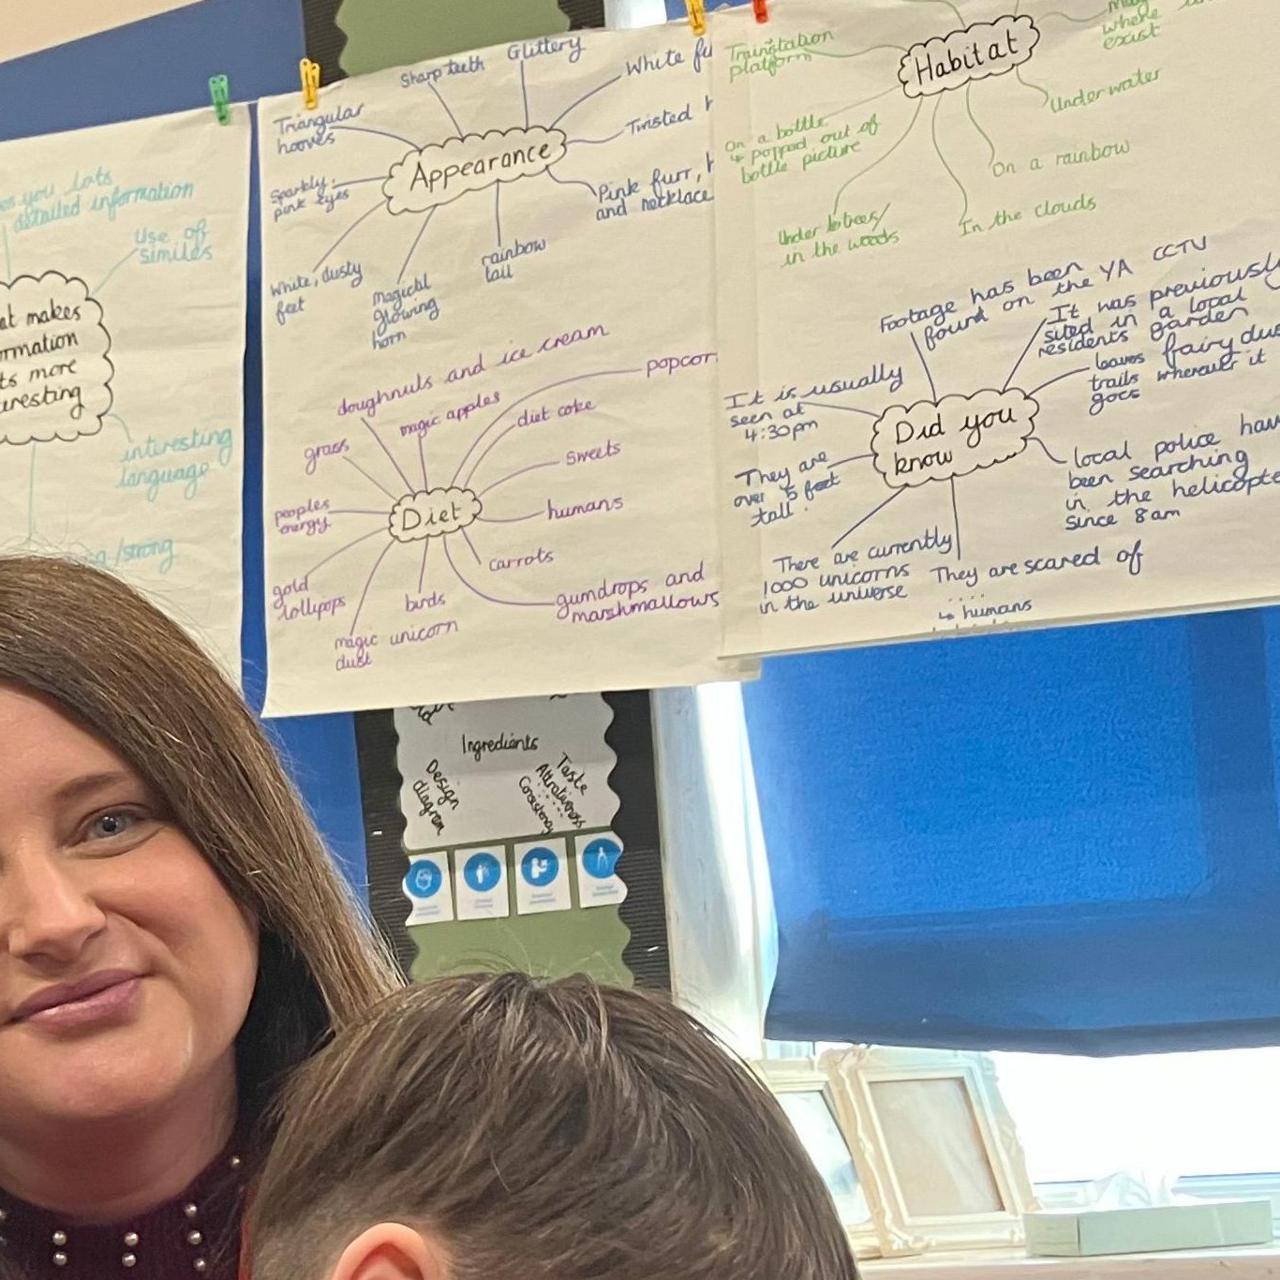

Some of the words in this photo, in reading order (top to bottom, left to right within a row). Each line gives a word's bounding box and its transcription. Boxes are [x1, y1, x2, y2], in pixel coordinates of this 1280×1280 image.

[507, 36, 586, 64] Glittery
[1103, 23, 1160, 50] exist
[400, 68, 442, 89] Sharp
[443, 55, 486, 76] teeth
[625, 50, 685, 77] White
[729, 52, 812, 84] platform
[915, 28, 1019, 85] Habitat
[272, 103, 365, 144] Triangular
[624, 104, 693, 137] Twisted
[757, 133, 767, 145] a
[776, 113, 828, 140] bottle
[820, 124, 850, 144] out
[857, 112, 880, 137] of
[409, 141, 552, 194] Appearance
[740, 161, 788, 184] bottle
[802, 141, 861, 171] picture
[992, 160, 1017, 178] On
[1030, 157, 1044, 171] a
[1056, 140, 1130, 166] rainbow
[91, 181, 194, 222] information
[596, 198, 628, 221] and
[641, 188, 714, 213] necklace
[598, 178, 640, 204] Pink
[134, 228, 168, 245] Use
[184, 218, 209, 249] of
[778, 226, 820, 246] Under
[959, 219, 982, 237] In
[988, 209, 1023, 230] the
[139, 241, 213, 265] similes
[481, 238, 548, 267] rainbow
[780, 252, 806, 269] in
[813, 241, 839, 258] the
[848, 228, 900, 252] woods
[1099, 259, 1134, 282] YA
[1152, 235, 1208, 261] CCTV
[321, 260, 363, 289] dusty
[485, 264, 513, 284] tail
[26, 298, 82, 327] makes
[276, 297, 305, 326] feet
[880, 300, 957, 334] Footage
[970, 280, 1015, 304] has
[1028, 262, 1083, 287] been
[924, 306, 989, 351] found
[1002, 295, 1035, 312] on
[1052, 276, 1094, 298] the
[1047, 303, 1080, 325] It
[1110, 313, 1138, 330] in
[1159, 306, 1174, 320] a
[1190, 286, 1248, 315] local
[373, 297, 440, 337] glowing
[1038, 330, 1129, 358] residents
[1150, 307, 1249, 342] garden
[372, 330, 407, 350] horn
[1095, 352, 1145, 370] leaves
[1162, 332, 1236, 368] fairy
[28, 359, 78, 383] more
[338, 373, 433, 417] doughnuts
[444, 352, 486, 384] and
[496, 340, 533, 368] ice
[537, 324, 609, 354] cream
[1089, 370, 1140, 392] trails
[1156, 357, 1238, 382] wherever
[1249, 348, 1266, 366] it
[724, 390, 764, 411] It
[774, 385, 798, 402] is
[800, 363, 903, 399] usually
[1089, 389, 1141, 416] goes
[446, 391, 501, 422] apples
[517, 407, 549, 428] diet
[558, 399, 597, 418] coke
[730, 411, 773, 428] seen
[783, 402, 806, 419] at
[745, 420, 818, 442] 4:30pm
[896, 413, 945, 445] Did
[959, 408, 1017, 449] you
[120, 427, 234, 467] interesting
[303, 438, 350, 475] grass
[895, 451, 953, 475] know
[1154, 432, 1221, 462] police
[115, 461, 210, 502] language
[735, 466, 792, 492] They
[799, 451, 828, 473] are
[1069, 471, 1114, 489] been
[1129, 449, 1249, 484] searching
[734, 492, 766, 508] over
[805, 471, 841, 501] feet
[1066, 493, 1088, 511] in
[1107, 488, 1152, 507] the
[274, 499, 330, 528] peoples
[402, 501, 462, 532] Diet
[547, 496, 624, 521] humans
[1065, 514, 1118, 530] since
[279, 516, 331, 536] energy
[489, 546, 554, 572] carrots
[773, 555, 820, 573] There
[834, 550, 859, 565] are
[868, 526, 953, 559] currently
[930, 566, 978, 588] They
[989, 562, 1020, 578] are
[1024, 546, 1101, 575] scared
[1116, 539, 1144, 576] of
[272, 575, 309, 610] gold
[556, 577, 649, 620] gumdrops
[665, 560, 705, 587] and
[763, 577, 808, 597] 1000
[819, 563, 910, 587] unicorns
[278, 596, 346, 621] lollipops
[405, 591, 446, 612] birds
[572, 590, 720, 623] marshmallows
[760, 601, 778, 615] in
[784, 595, 820, 611] the
[828, 584, 908, 605] universe
[963, 600, 1033, 620] humans
[335, 633, 378, 657] magic
[390, 620, 458, 646] unicorn
[336, 652, 372, 671] dust
[462, 732, 539, 762] Ingredients
[425, 758, 460, 811] Design
[555, 752, 588, 796] Taste
